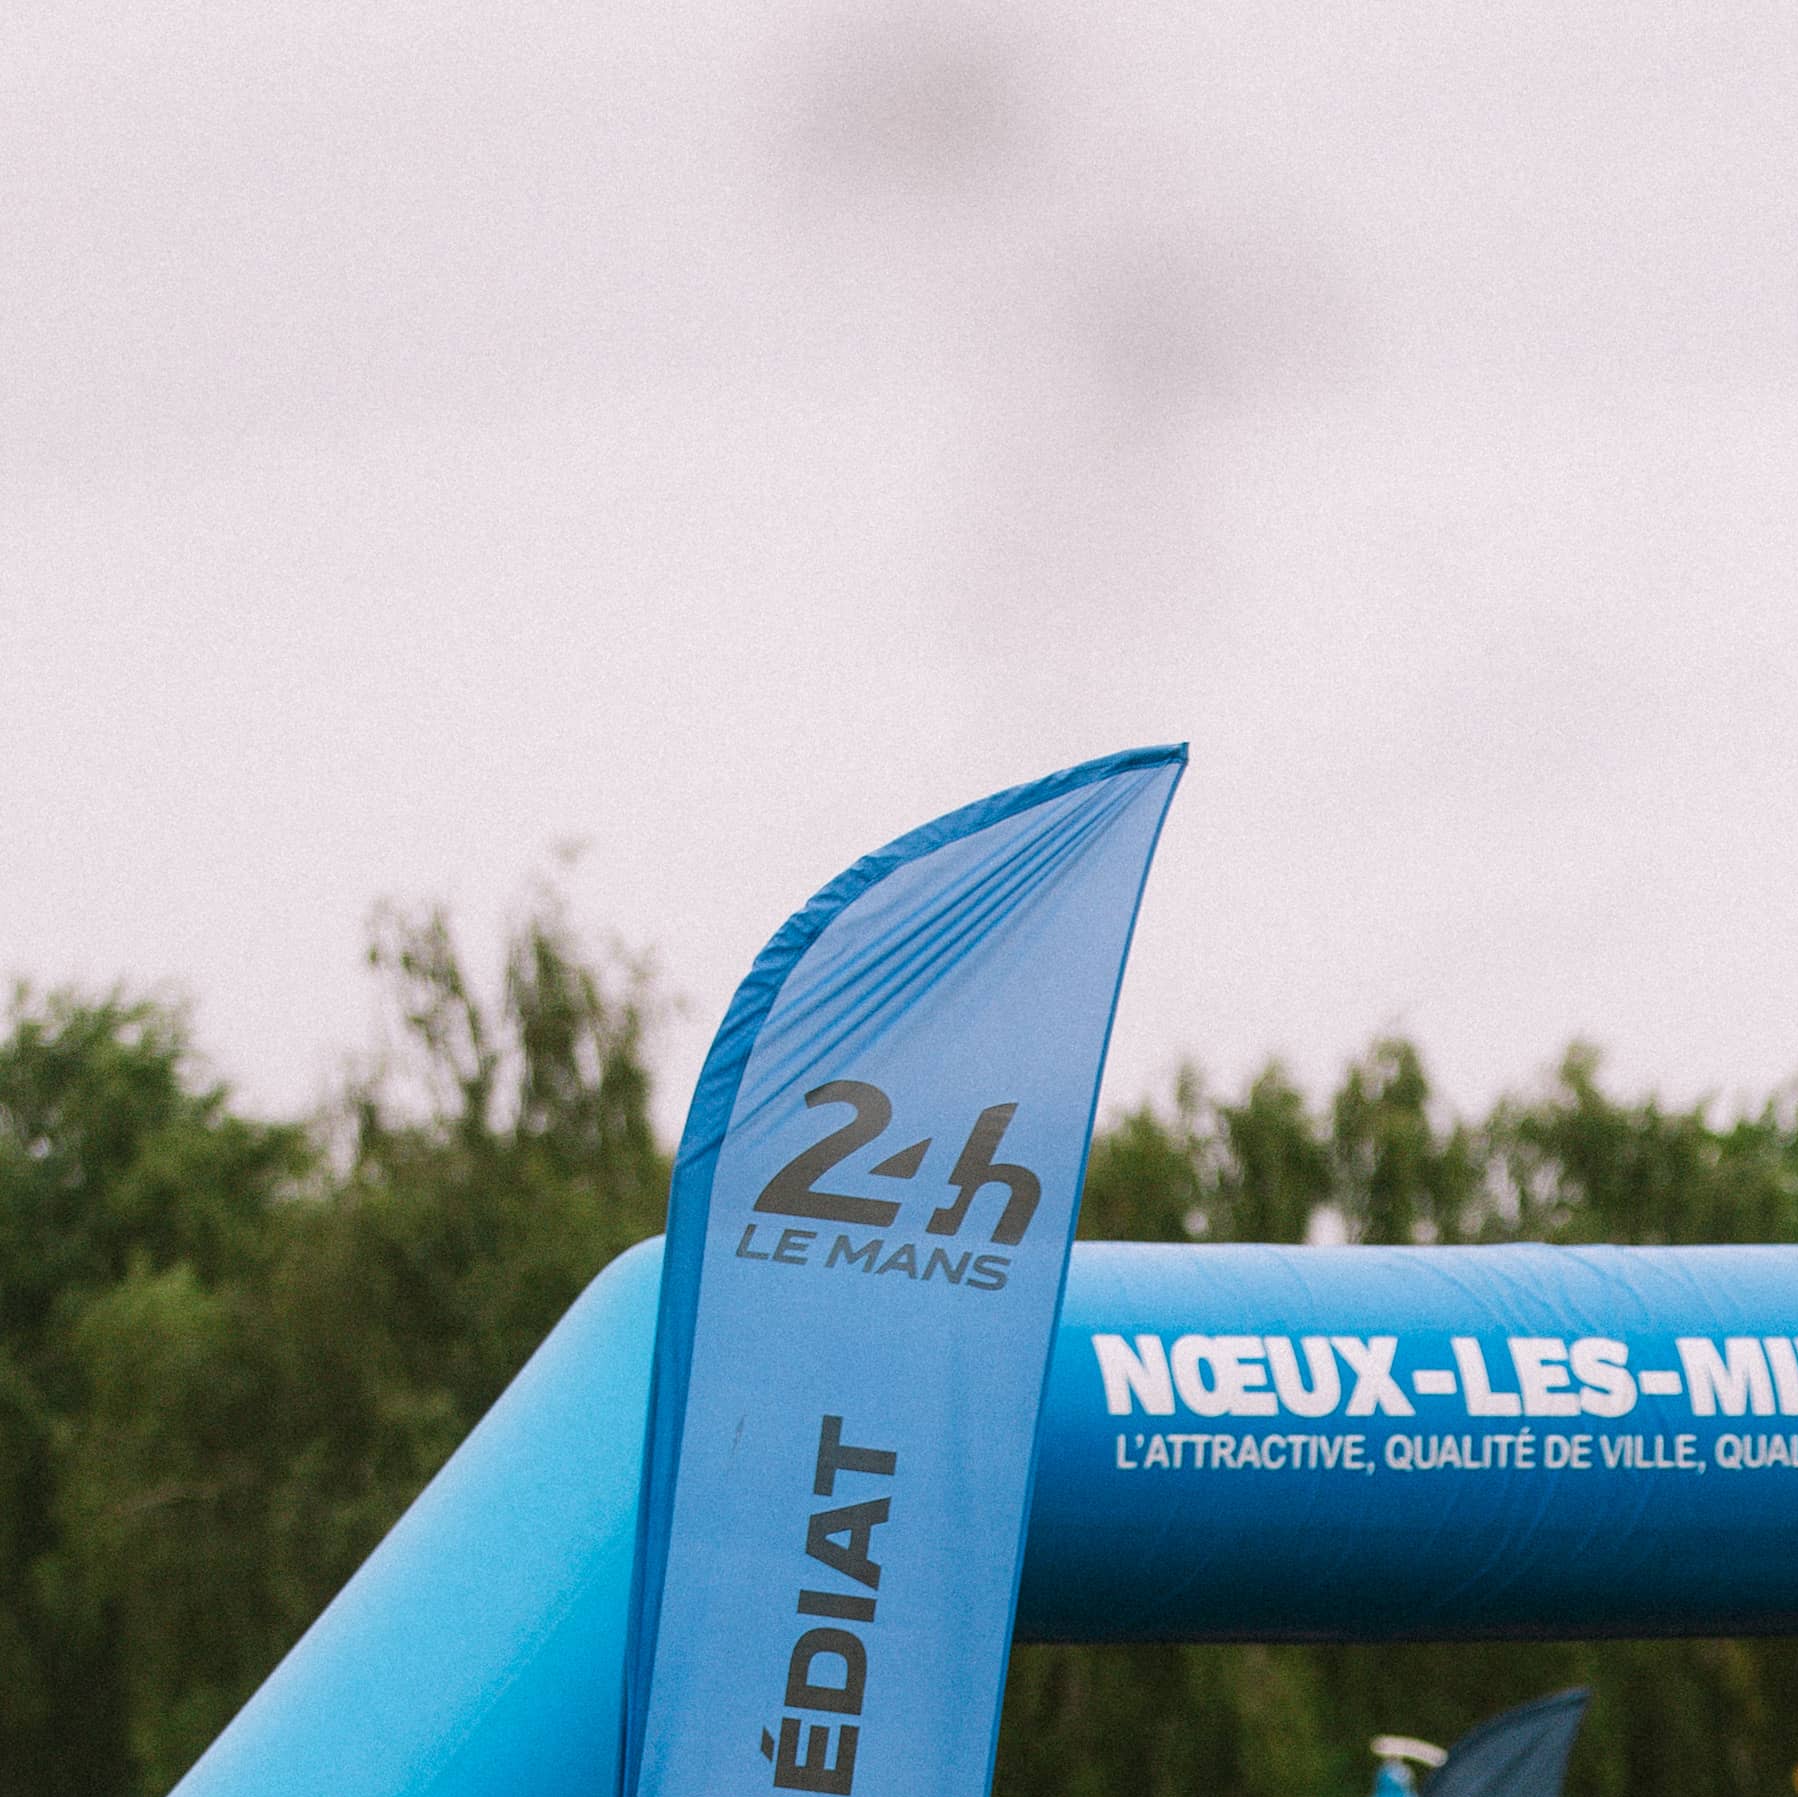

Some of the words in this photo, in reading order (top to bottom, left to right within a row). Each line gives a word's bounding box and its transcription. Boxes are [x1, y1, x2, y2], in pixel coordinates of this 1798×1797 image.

[736, 1223, 817, 1267] LE
[824, 1235, 1013, 1291] MANS
[1116, 1433, 1376, 1474] L'ATTRACTIVE,
[1385, 1428, 1535, 1470] QUALITÉ
[1544, 1434, 1592, 1469] DE
[1599, 1434, 1706, 1472] VILLE,
